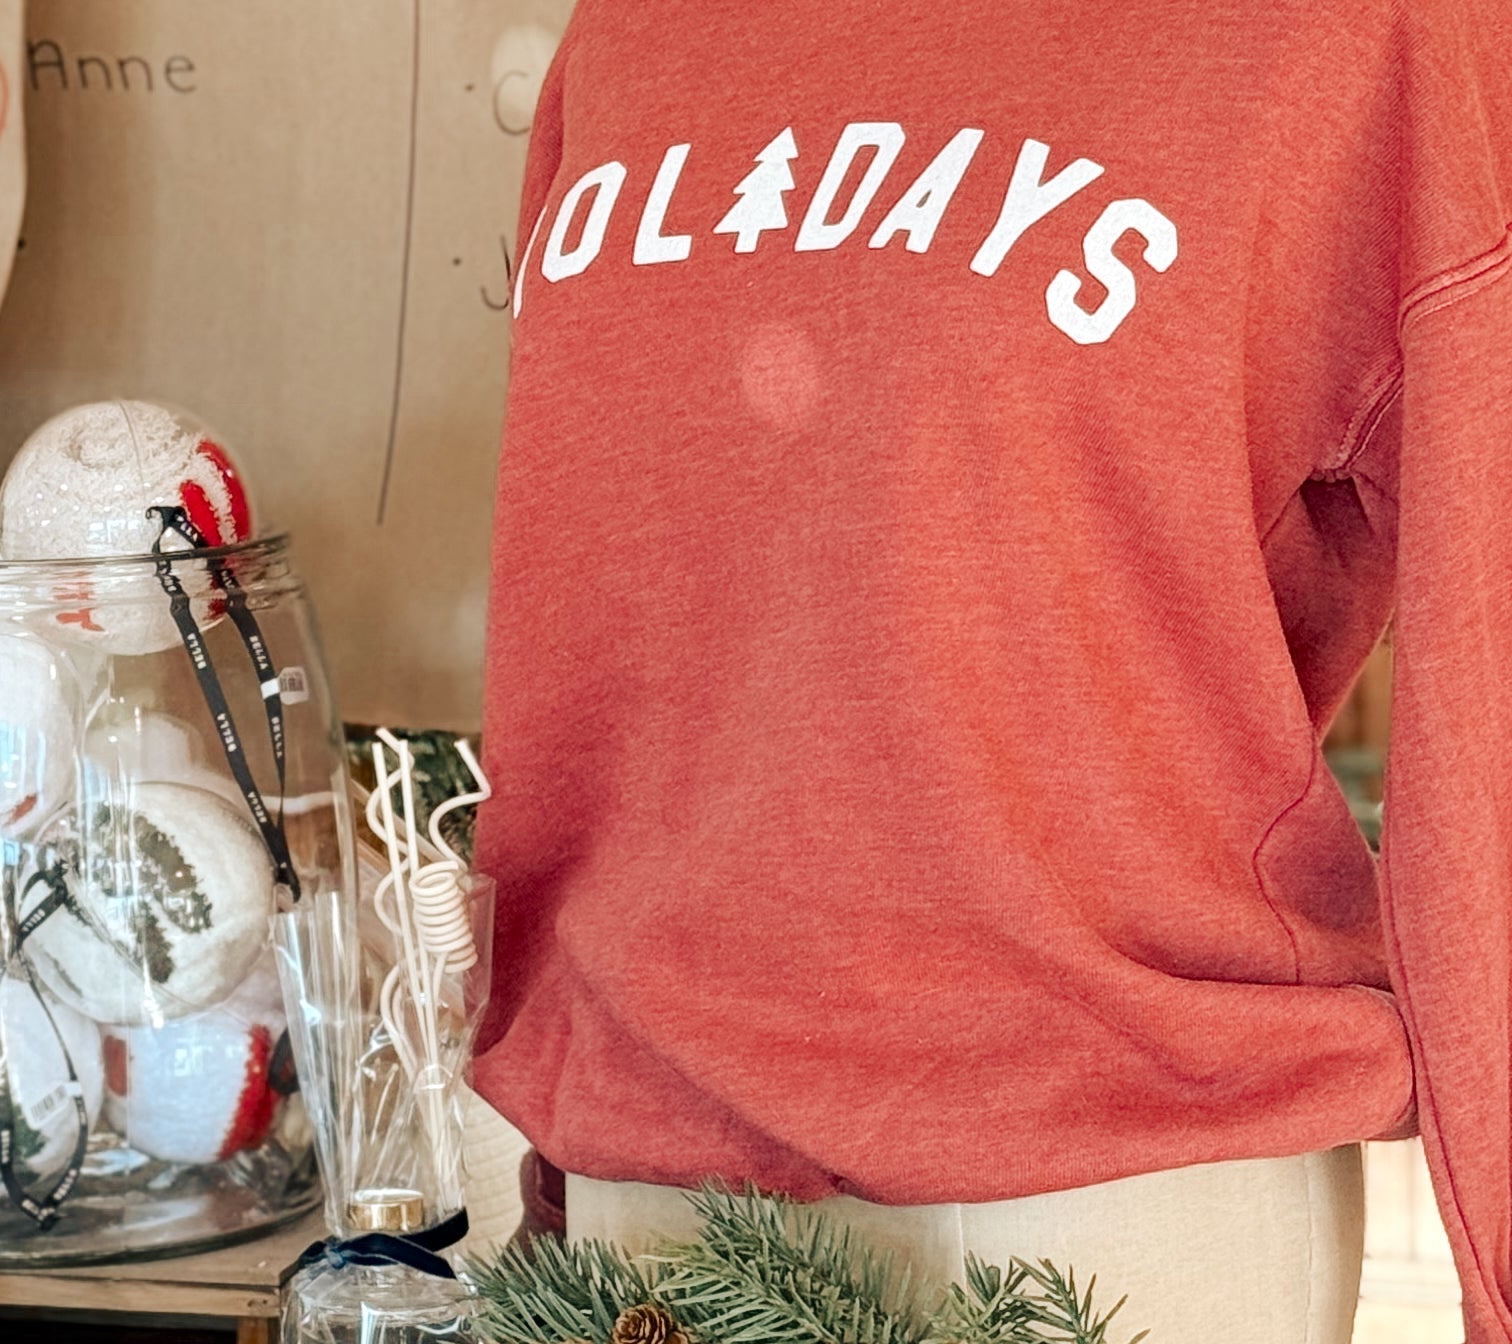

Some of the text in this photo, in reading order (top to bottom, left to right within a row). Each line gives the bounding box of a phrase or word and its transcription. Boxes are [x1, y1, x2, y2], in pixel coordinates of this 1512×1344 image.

[27, 37, 198, 94] Anne
[248, 634, 270, 671] BELLA
[216, 712, 238, 754] BELLA
[247, 790, 268, 824] BELLA
